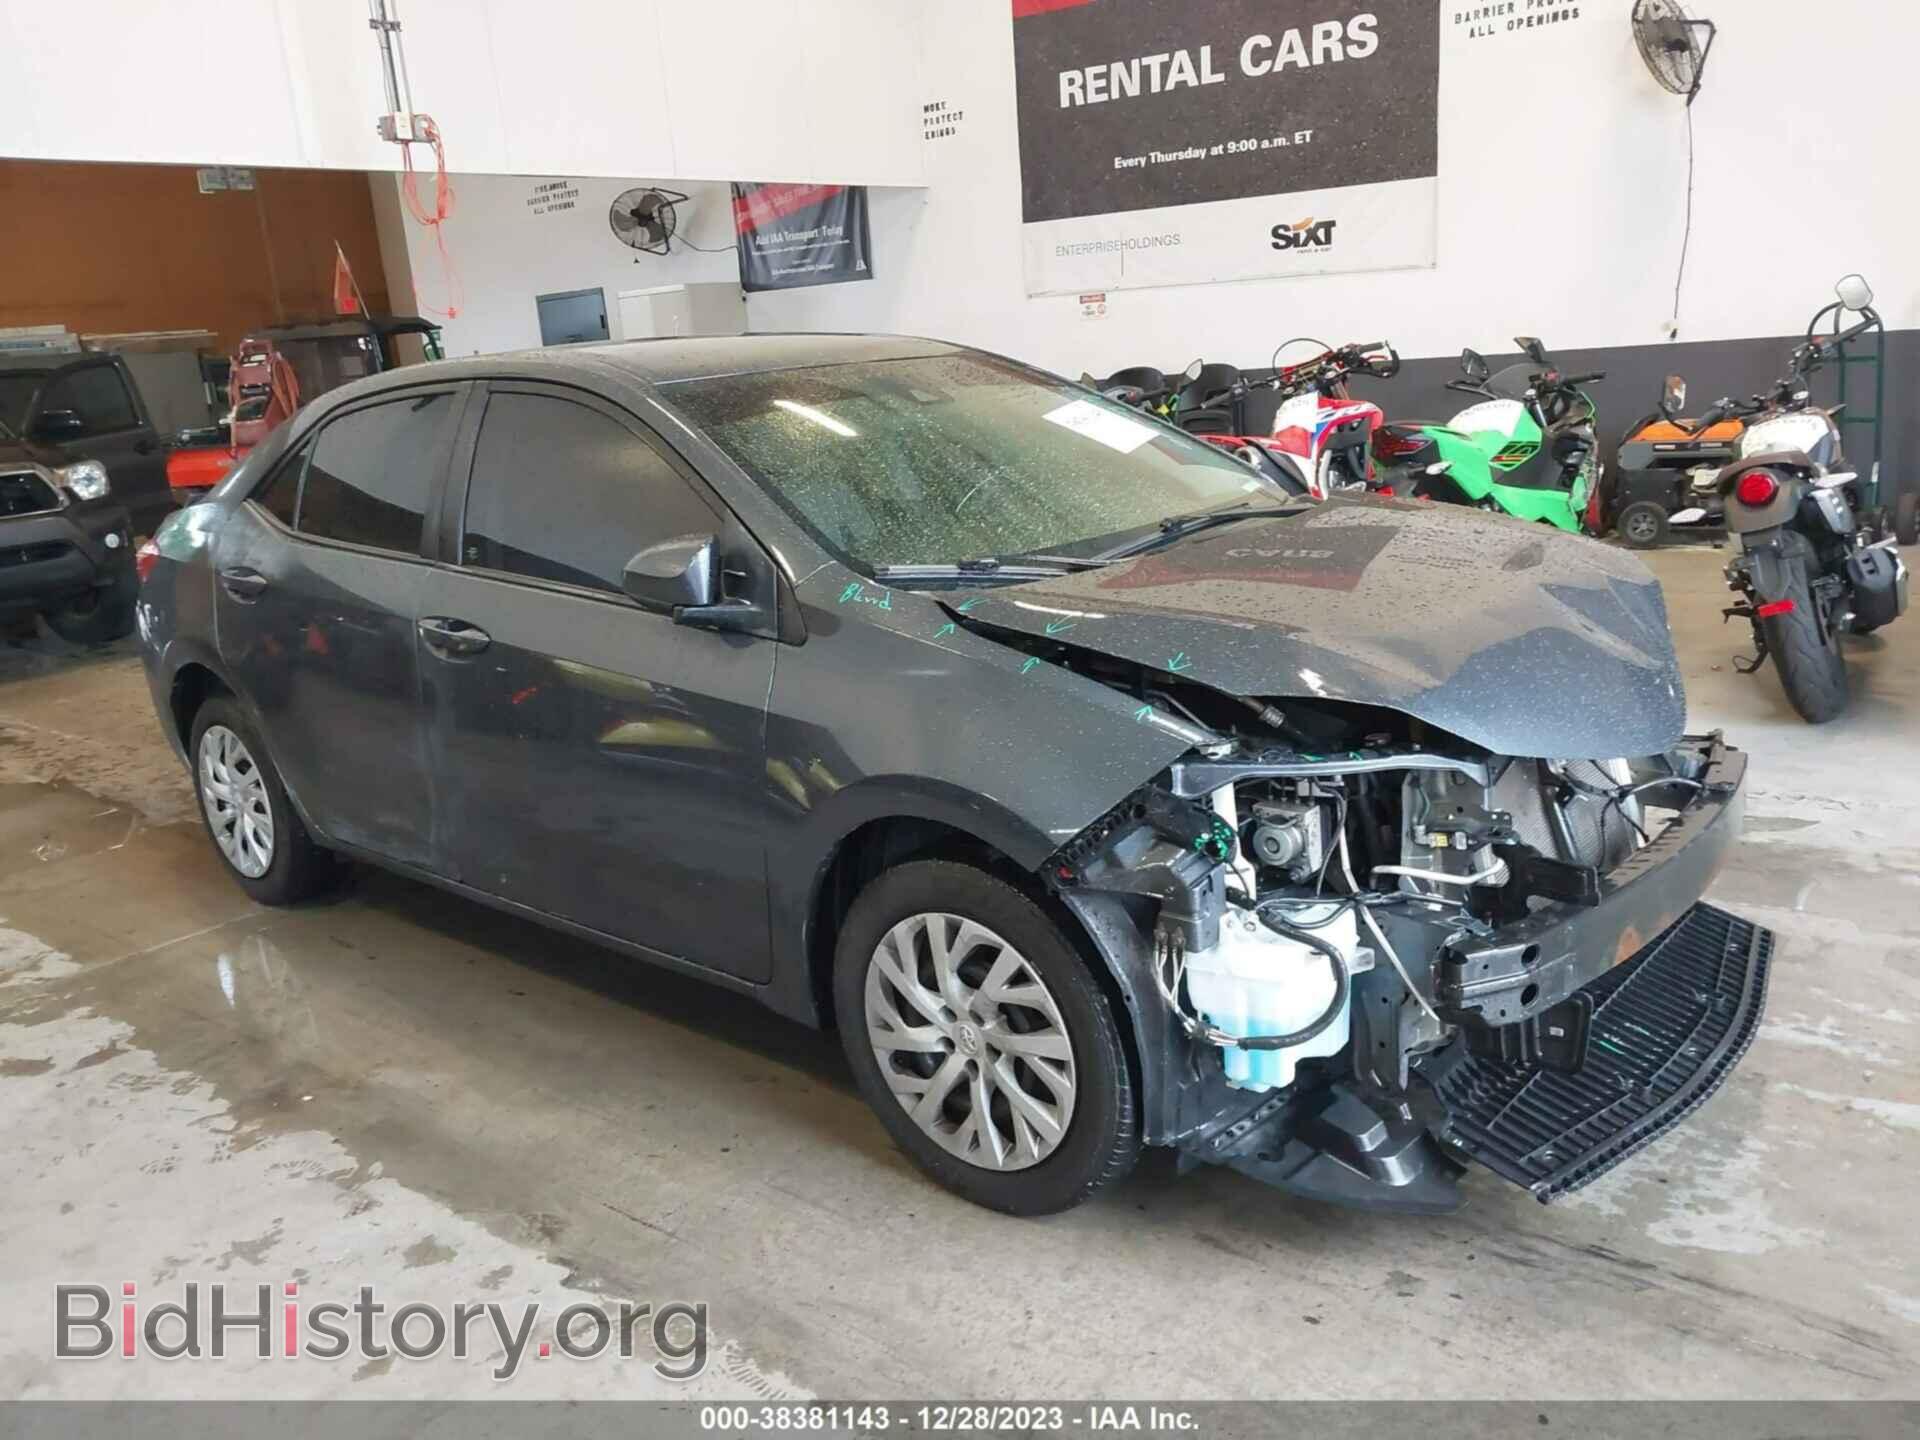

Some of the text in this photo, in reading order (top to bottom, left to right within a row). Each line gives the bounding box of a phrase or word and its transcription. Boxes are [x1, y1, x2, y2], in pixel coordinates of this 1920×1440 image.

[1454, 2, 1515, 24] BARRIER
[1469, 8, 1580, 38] ALL OPENINGS
[1059, 13, 1379, 108] RENTAL CARS
[1114, 130, 1314, 169] Every Thursday at 9:00 a.m. ET
